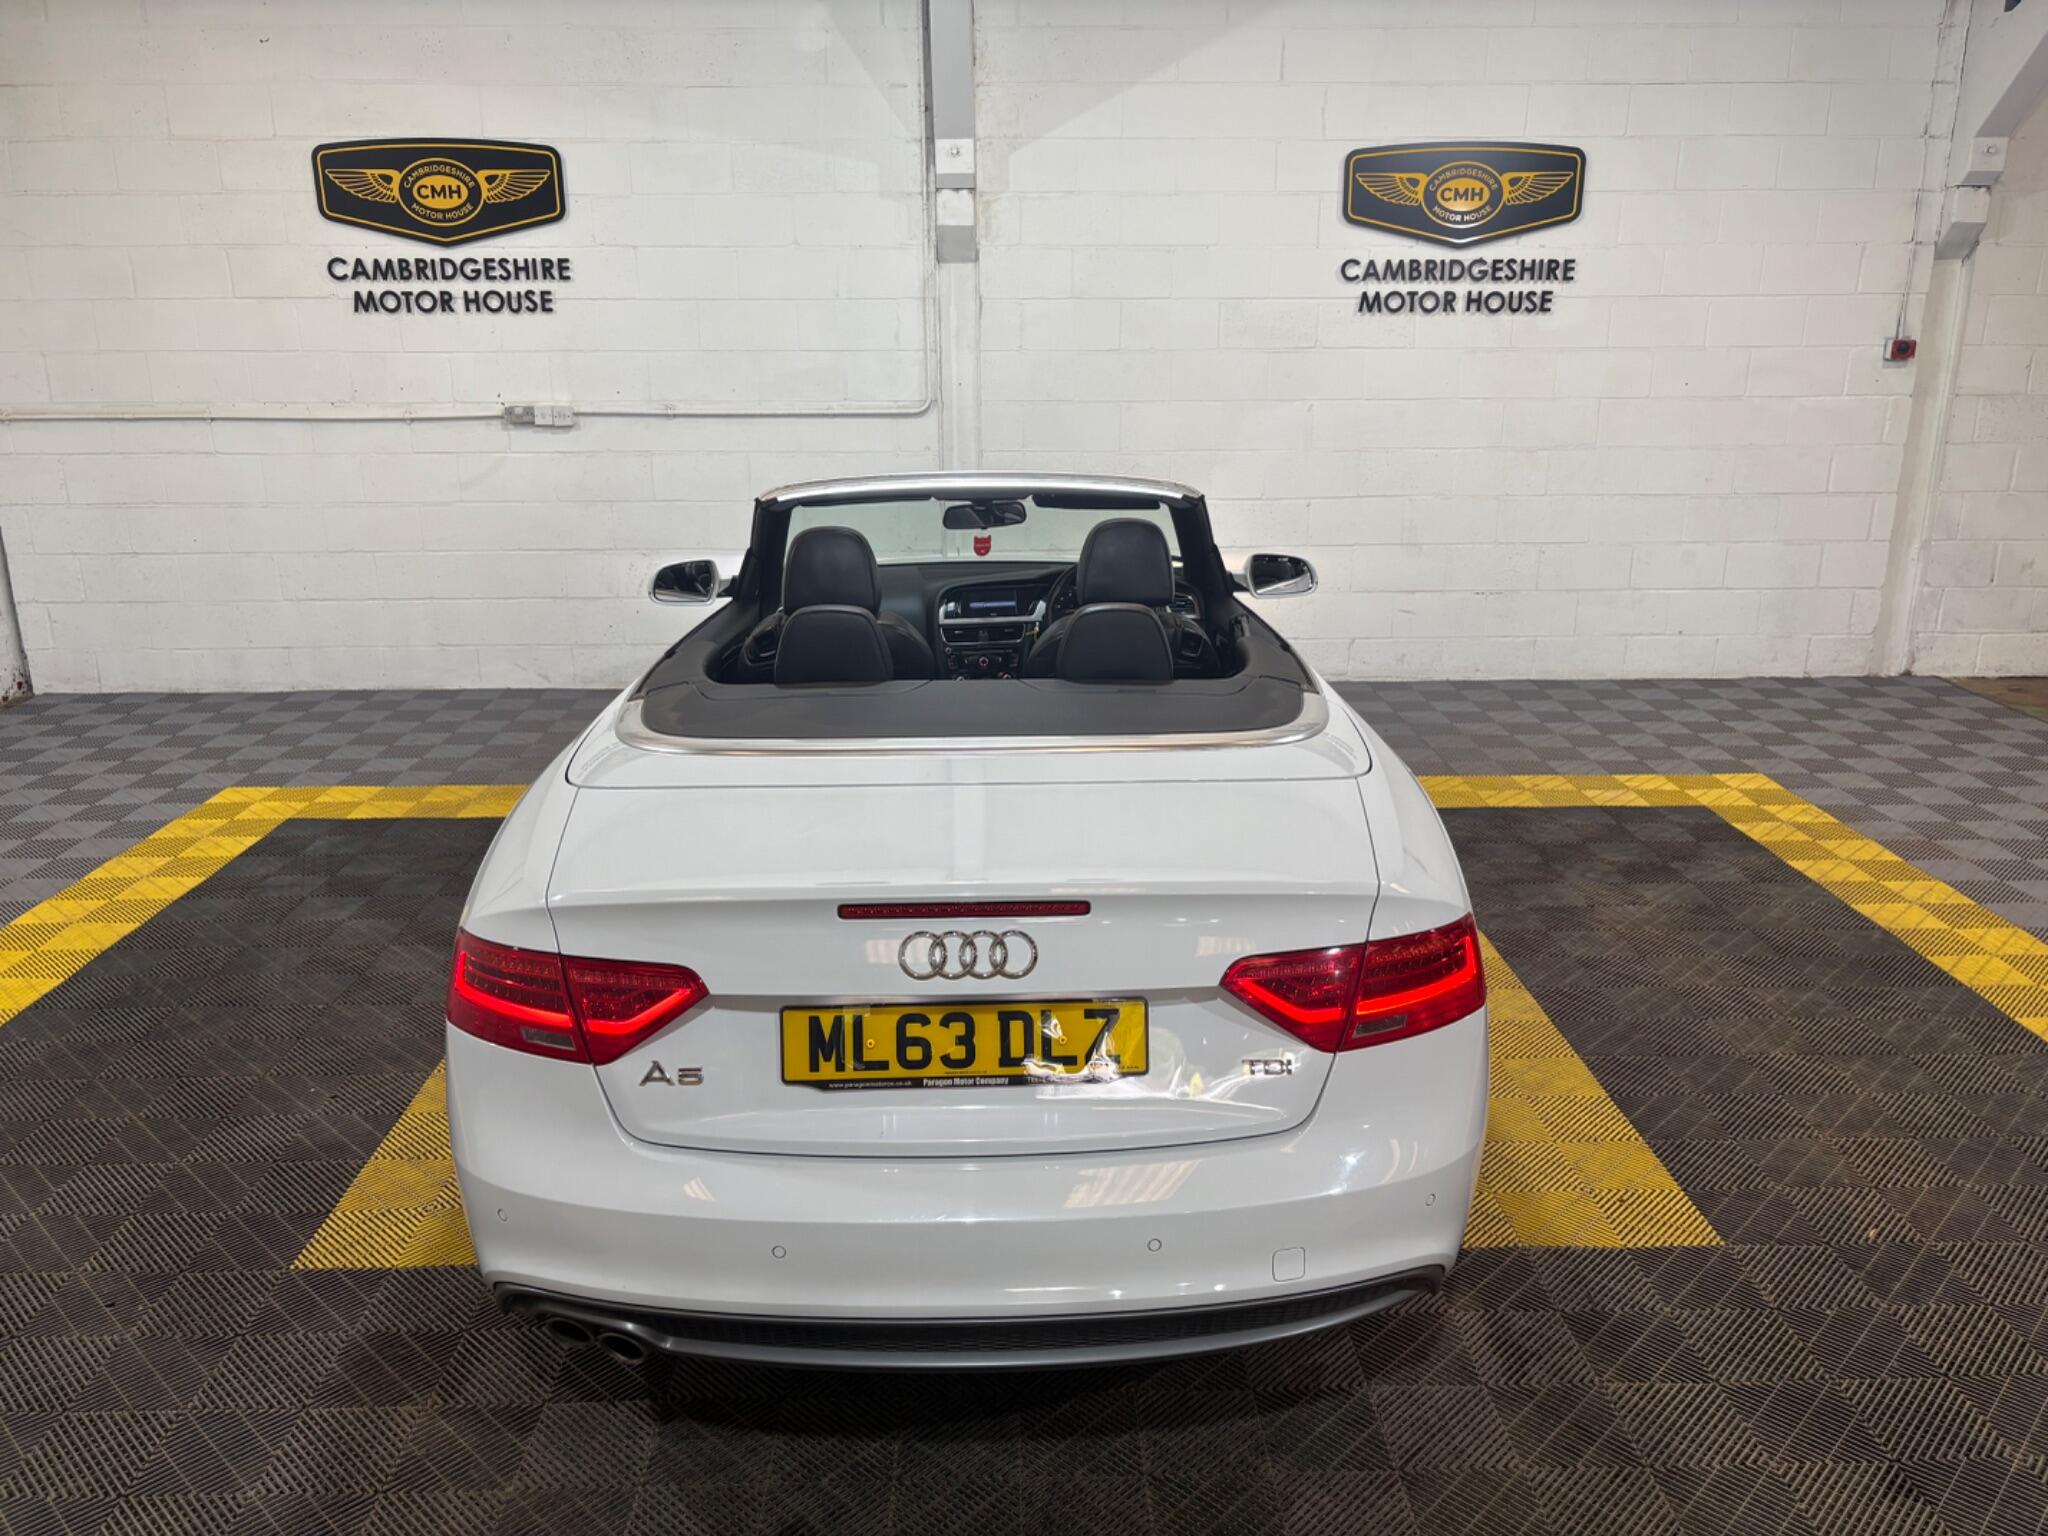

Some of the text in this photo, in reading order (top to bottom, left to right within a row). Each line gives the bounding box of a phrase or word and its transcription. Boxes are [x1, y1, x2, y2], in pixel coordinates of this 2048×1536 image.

[404, 165, 475, 188] CAMBRIDGESHIRE
[1429, 168, 1497, 191] CAMBRIDGESHIRE
[417, 184, 462, 199] CMH
[1440, 187, 1484, 201] CMH
[411, 202, 473, 219] MOTOR HOUSE
[1432, 205, 1491, 222] MOTOR HOUSE
[327, 258, 571, 281] CAMBRIDGESHIRE
[1341, 259, 1575, 281] CAMBRIDGESHIRE
[353, 290, 553, 313] MOTOR HOUSE
[1358, 291, 1553, 313] MOTOR HOUSE
[809, 1011, 976, 1073] ML63
[639, 1060, 704, 1086] A5
[1241, 1059, 1292, 1075] TDI
[923, 1078, 953, 1087] Paragon
[954, 1077, 974, 1086] Motor
[976, 1076, 1009, 1086] Company
